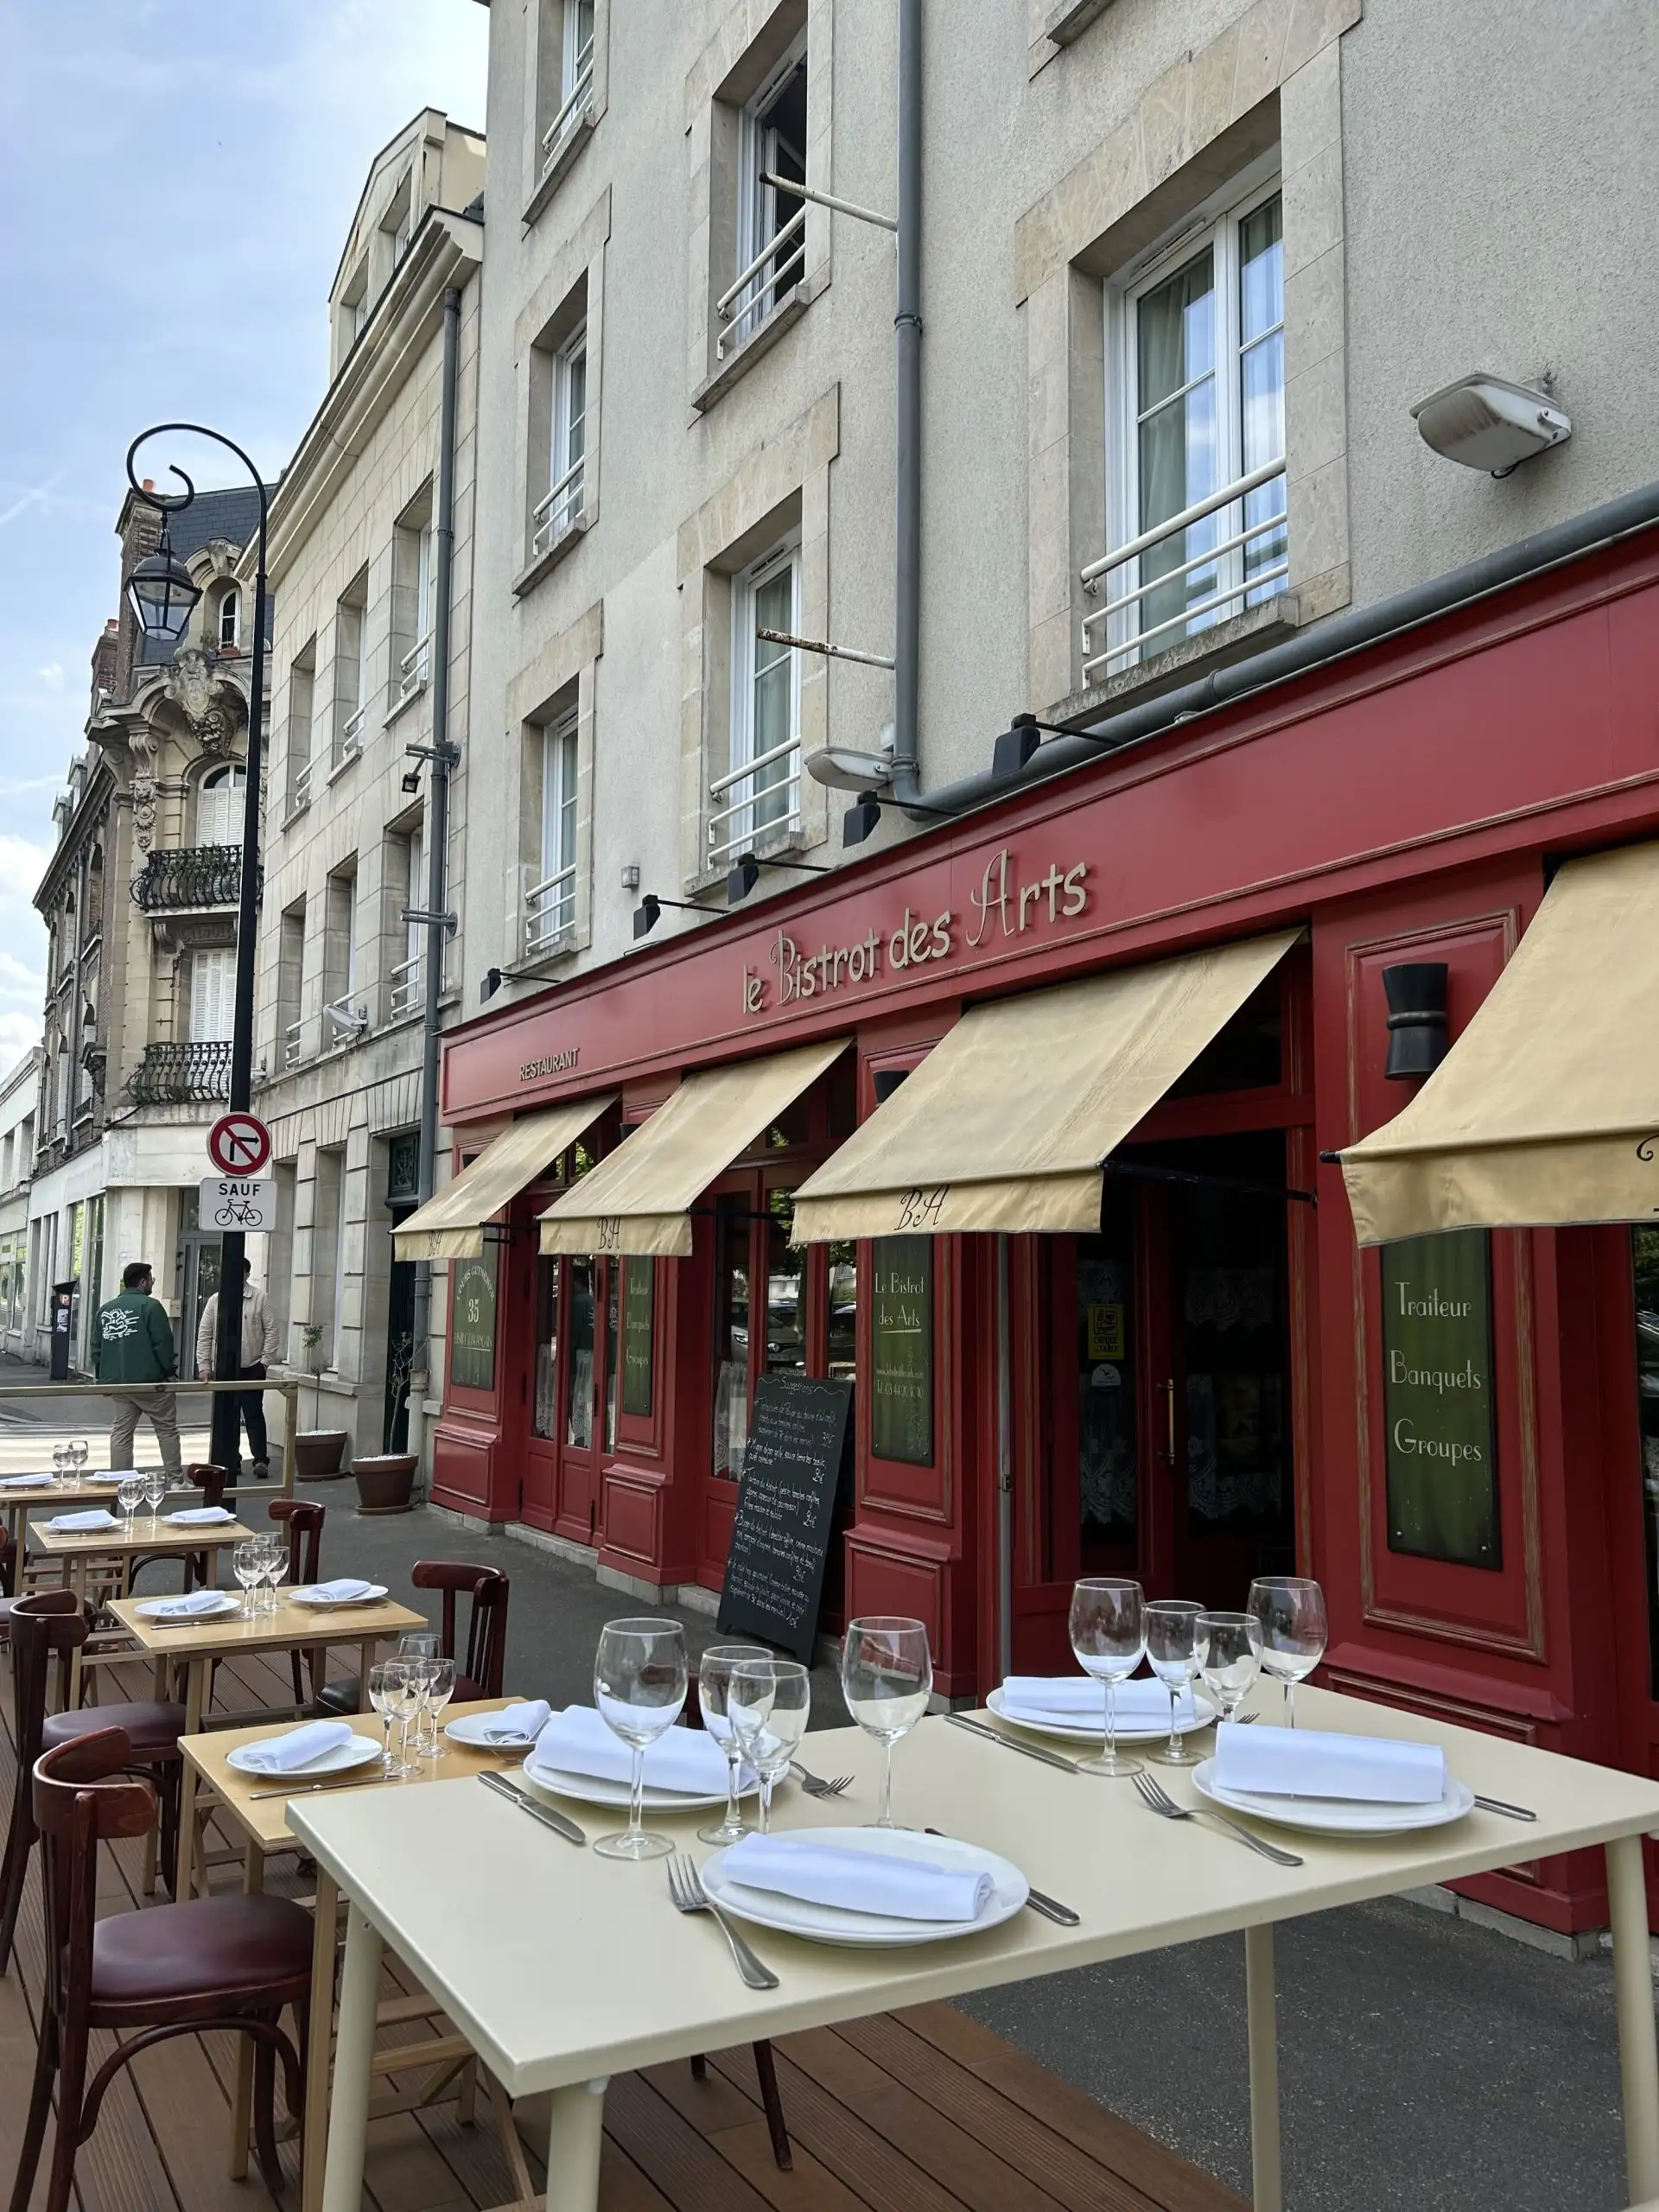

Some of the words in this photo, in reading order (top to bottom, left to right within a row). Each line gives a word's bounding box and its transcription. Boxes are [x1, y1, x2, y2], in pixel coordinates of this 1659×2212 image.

[743, 964, 763, 1014] le
[770, 928, 880, 1007] Bistrot
[889, 907, 951, 969] des
[965, 849, 1088, 947] Arts
[519, 1047, 579, 1081] RESTAURANT
[219, 1183, 261, 1196] SAUF
[875, 1272, 887, 1294] Le
[891, 1272, 925, 1294] Bistrot
[1394, 1281, 1471, 1317] Traiteur
[467, 1298, 480, 1323] 35
[878, 1303, 893, 1325] des
[897, 1304, 920, 1327] Arts
[1390, 1350, 1481, 1395] Banquets
[1394, 1418, 1482, 1466] Groupes
